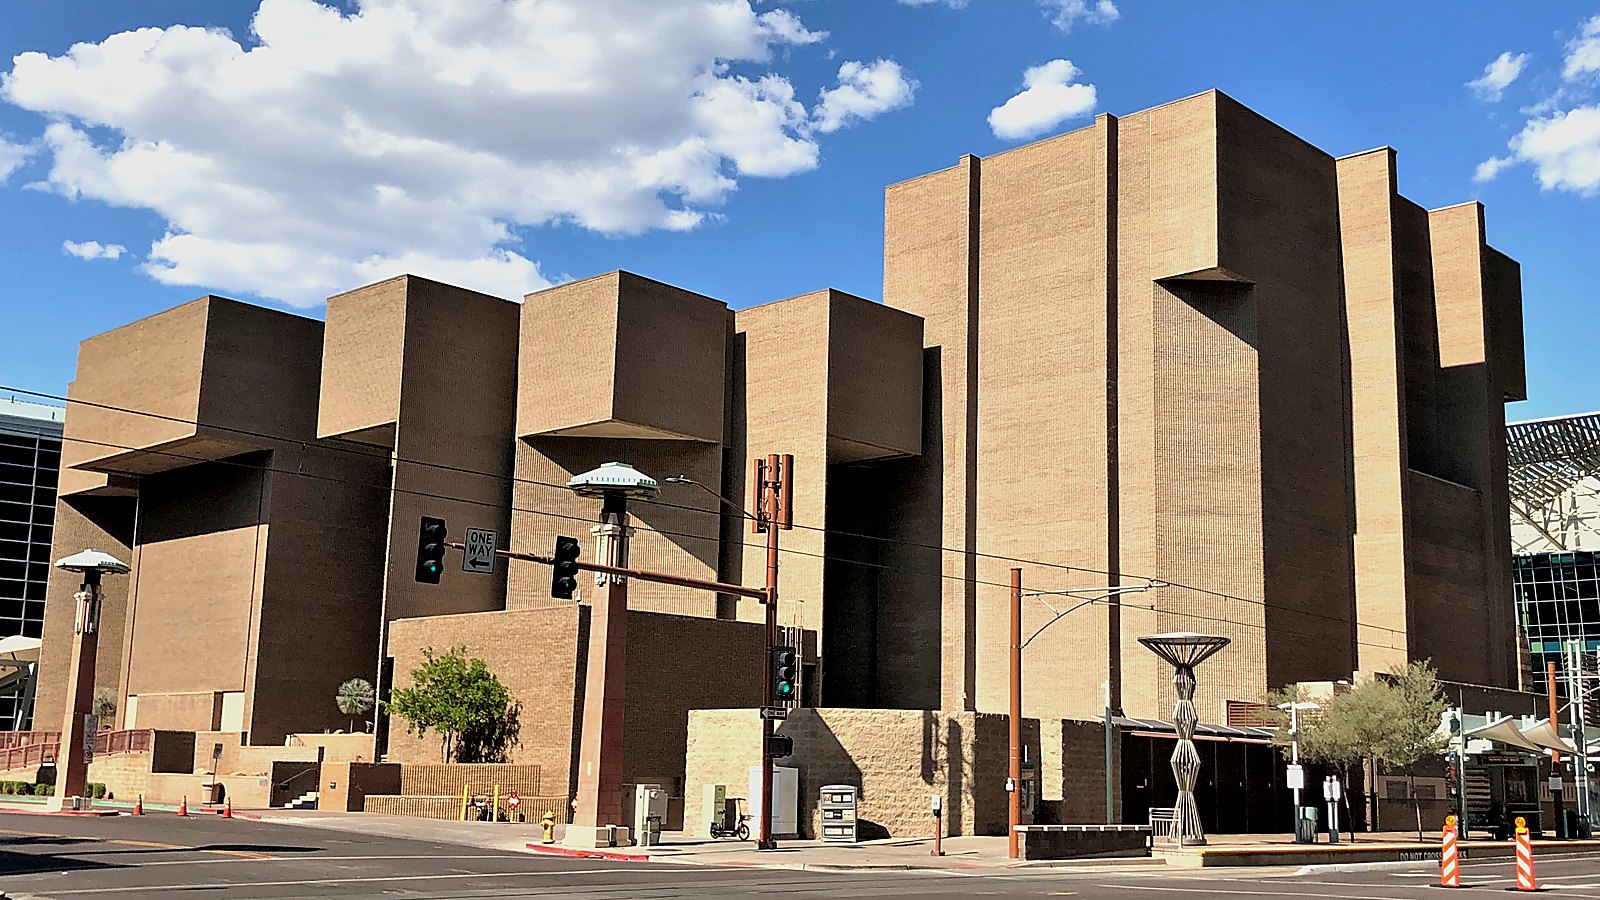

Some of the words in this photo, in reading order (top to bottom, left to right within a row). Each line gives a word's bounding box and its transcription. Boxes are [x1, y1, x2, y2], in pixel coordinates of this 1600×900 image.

[471, 532, 492, 544] ONE
[469, 544, 492, 556] WAY
[1400, 852, 1409, 861] DO
[1410, 852, 1422, 861] NOT
[1424, 852, 1442, 860] CROSS
